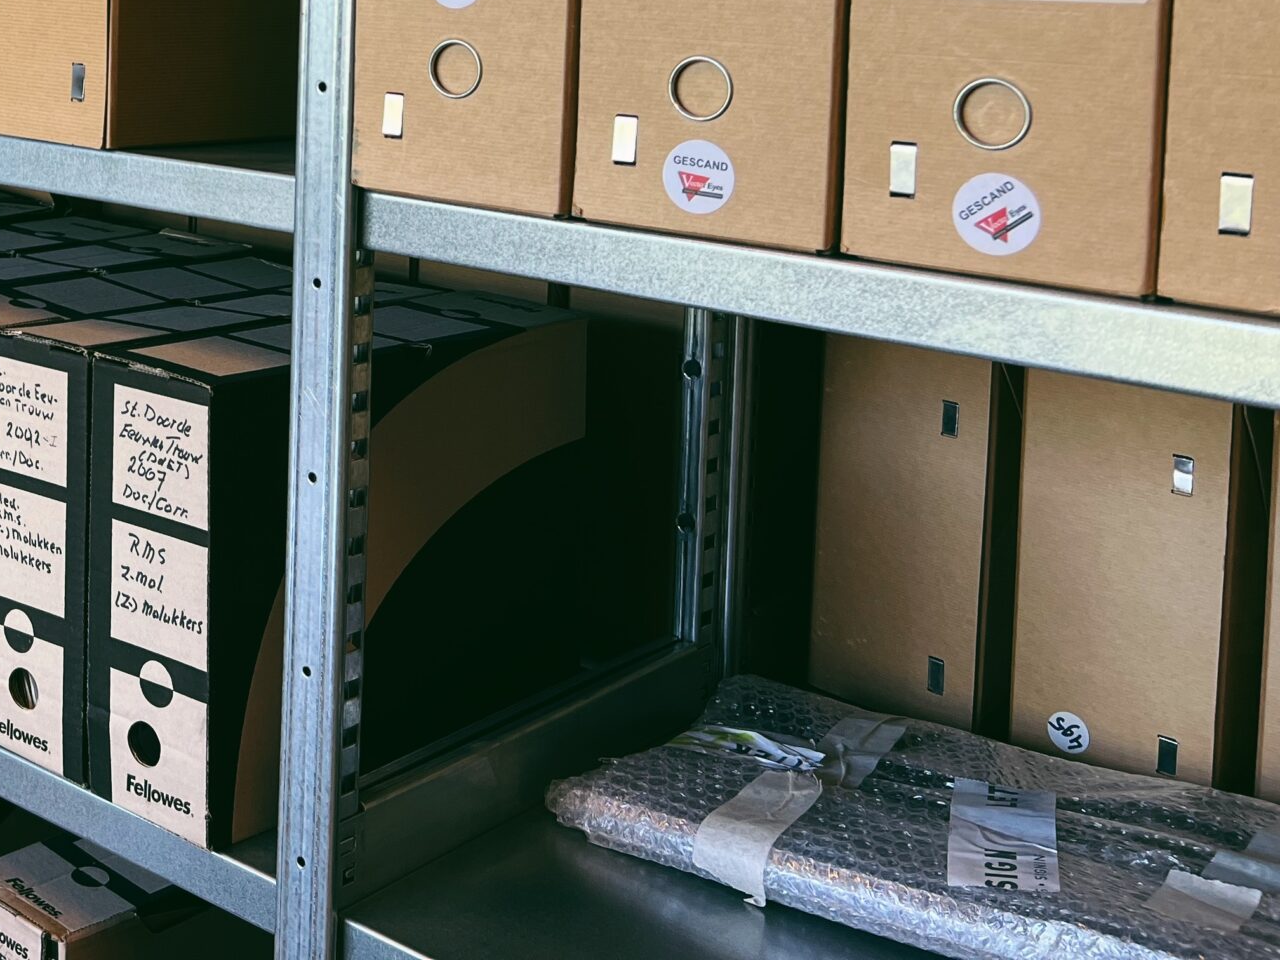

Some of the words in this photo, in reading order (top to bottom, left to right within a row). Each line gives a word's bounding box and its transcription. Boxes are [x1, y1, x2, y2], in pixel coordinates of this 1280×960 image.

[673, 155, 728, 171] GESCAND
[708, 183, 723, 191] Eyes
[959, 181, 1015, 220] GESCAND
[15, 399, 54, 420] Trouw
[121, 401, 140, 418] St.
[166, 436, 203, 464] Trouw
[126, 774, 191, 816] Fellowes
[5, 877, 63, 918] Fellowes
